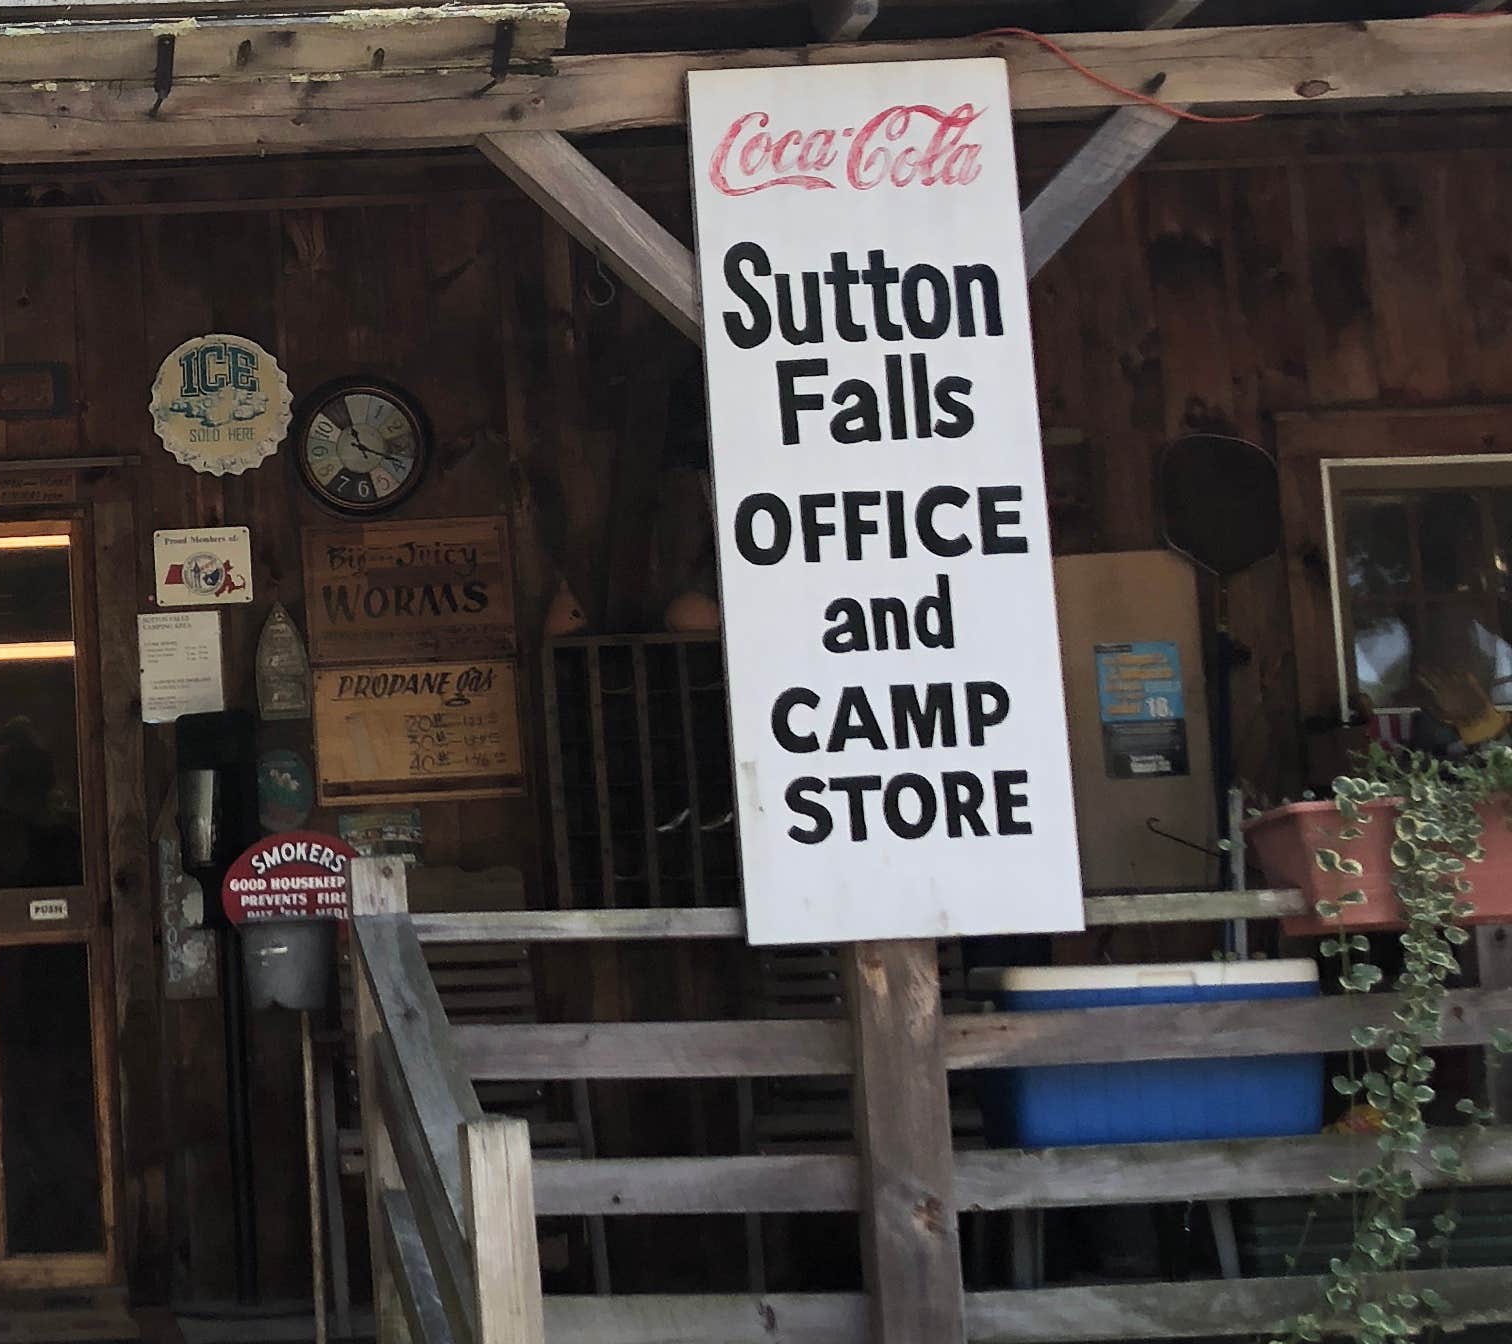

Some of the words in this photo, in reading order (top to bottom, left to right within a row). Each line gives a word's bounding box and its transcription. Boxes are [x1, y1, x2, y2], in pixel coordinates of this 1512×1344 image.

[709, 102, 989, 197] Coca-Cola
[723, 242, 1003, 349] Sutton
[179, 343, 259, 397] ICE
[776, 353, 974, 445] Falls
[189, 427, 221, 443] SOLD
[227, 425, 257, 442] HERE
[735, 486, 1028, 565] OFFICE
[327, 545, 367, 577] Big
[395, 540, 478, 577] Juicy
[322, 580, 489, 625] WORMS
[823, 574, 954, 653] and
[337, 671, 452, 698] PROPANE
[772, 681, 1009, 753] CAMP
[785, 770, 1032, 844] STORE
[229, 878, 267, 892] GOOD
[270, 875, 346, 891] HOUSEKEEP
[251, 841, 347, 875] SMOKERS
[240, 892, 308, 907] PREVENTS
